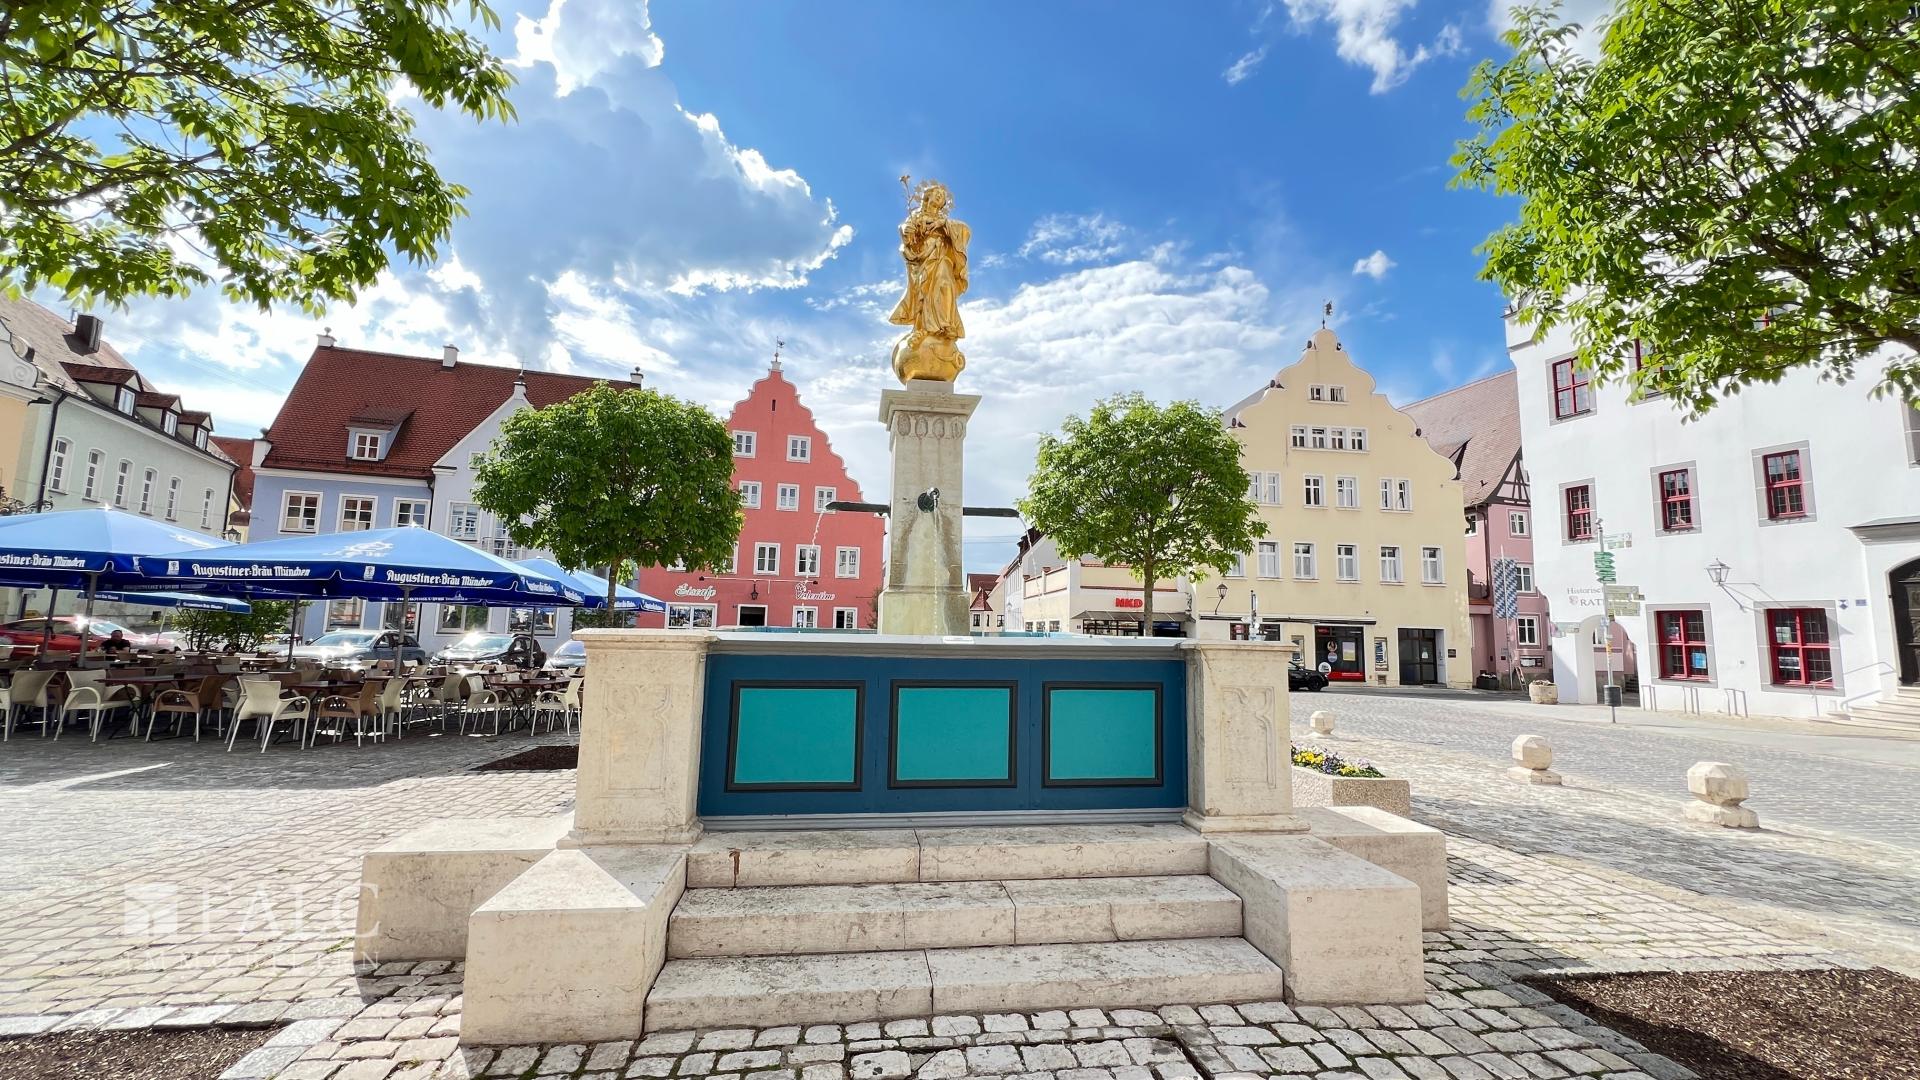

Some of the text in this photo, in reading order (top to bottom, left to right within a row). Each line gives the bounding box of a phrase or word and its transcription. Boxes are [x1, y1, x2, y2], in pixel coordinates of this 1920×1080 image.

[274, 565, 310, 577] München
[1115, 597, 1143, 608] NKD
[1580, 598, 1604, 607] RAT
